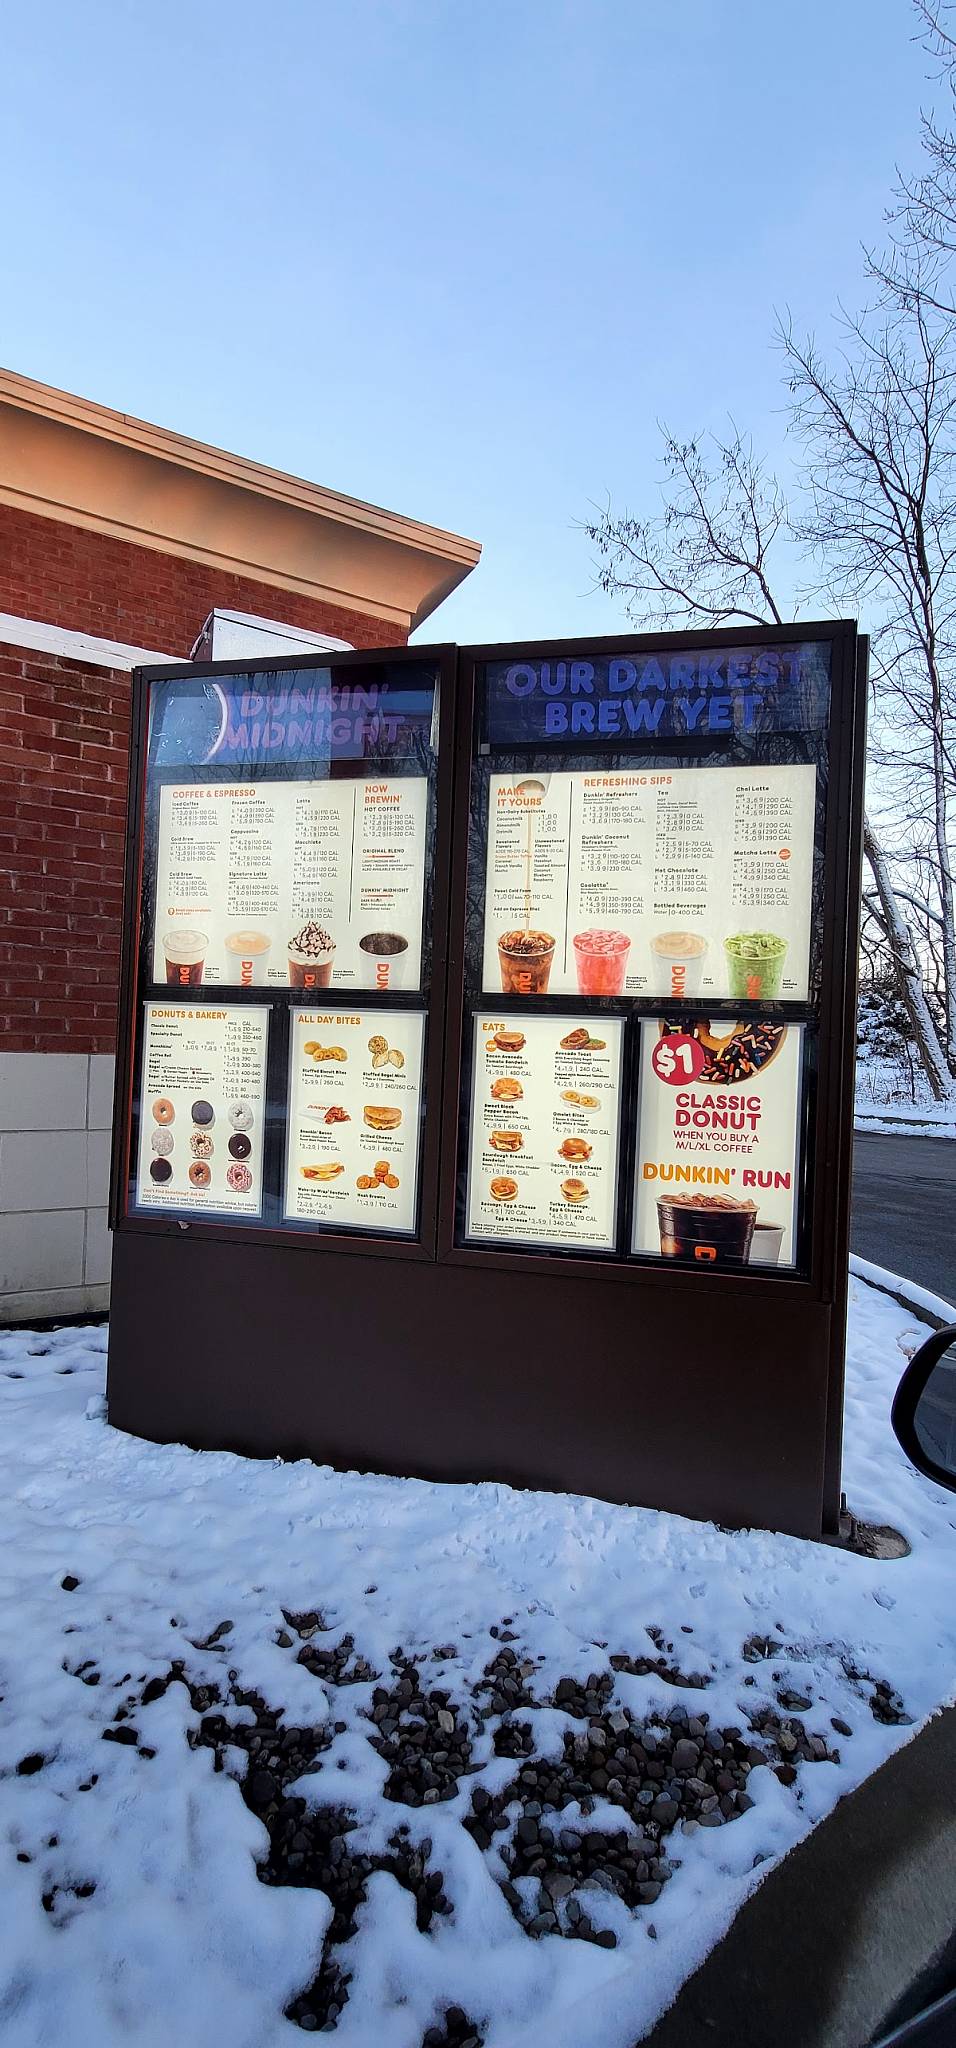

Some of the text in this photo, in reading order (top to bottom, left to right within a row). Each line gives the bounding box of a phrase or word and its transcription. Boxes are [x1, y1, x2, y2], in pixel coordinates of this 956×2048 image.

[506, 652, 808, 696] OUR DARKEST
[240, 683, 389, 717] DUNKIN'
[545, 695, 764, 734] BREW YET
[221, 715, 406, 750] MIDNIGHT
[584, 776, 672, 787] REFRESHING SIPS
[215, 789, 256, 797] ESPRESSO
[365, 785, 388, 793] NOW
[498, 788, 525, 796] MAKE
[365, 795, 402, 804] BREWIN'
[510, 798, 542, 806] YOURS
[151, 1010, 185, 1018] DONUTS
[195, 1011, 227, 1019] BAKERY
[298, 1015, 361, 1025] ALL DAY BITES
[482, 1023, 505, 1031] EATS
[656, 1044, 694, 1077] $1
[676, 1093, 761, 1112] CLASSIC
[675, 1109, 761, 1131] DONUT
[673, 1131, 759, 1143] WHEN YOU BUY A
[676, 1141, 752, 1153] M/L/XL COFFEE
[642, 1162, 791, 1190] DUNKIN' RUN
